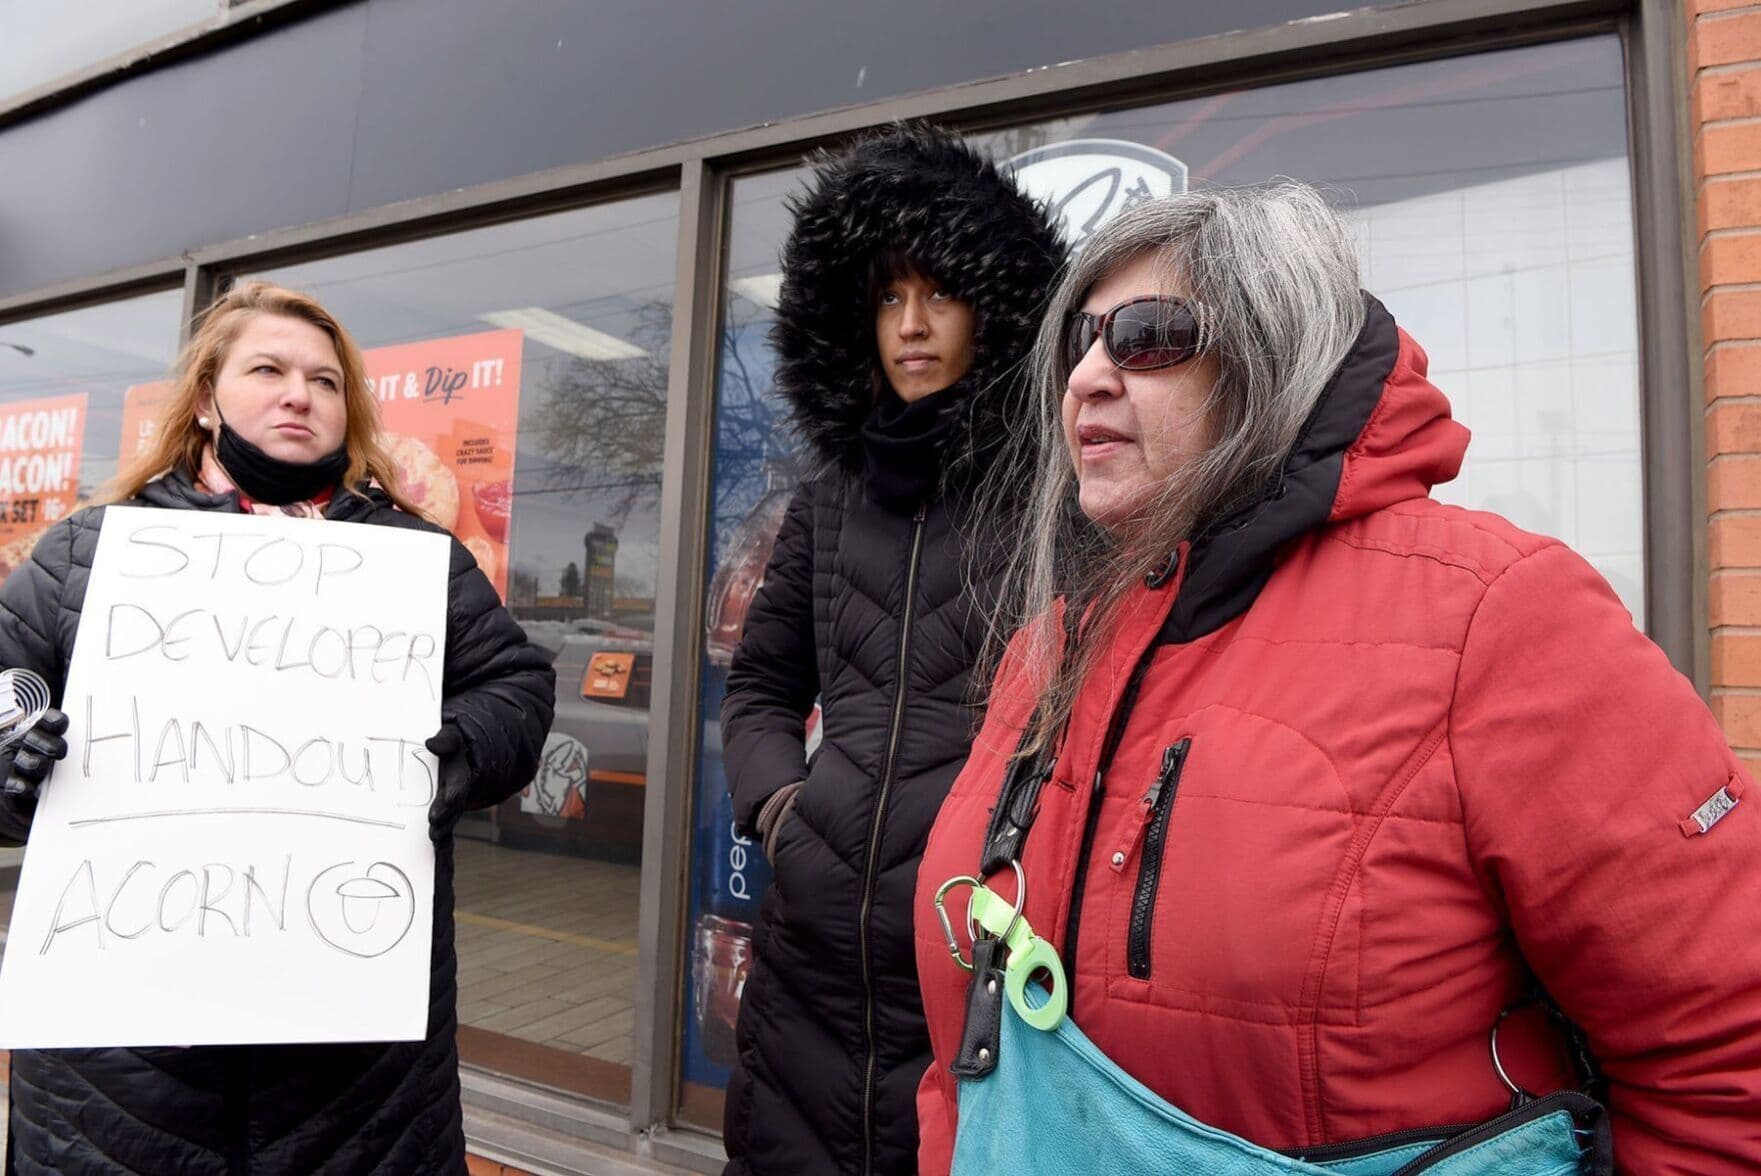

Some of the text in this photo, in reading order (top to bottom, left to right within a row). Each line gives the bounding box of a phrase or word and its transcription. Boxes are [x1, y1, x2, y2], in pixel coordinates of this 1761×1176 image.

[379, 373, 401, 401] IT
[403, 371, 420, 399] &
[425, 366, 468, 405] Dip
[471, 357, 505, 389] IT!
[0, 407, 78, 451] ACON!
[12, 499, 39, 523] SET
[119, 525, 364, 596] STOP
[106, 603, 436, 701] DEVELOPER
[83, 694, 434, 807] HANDOUTS
[728, 820, 753, 900] pep
[40, 853, 292, 956] ACORN
